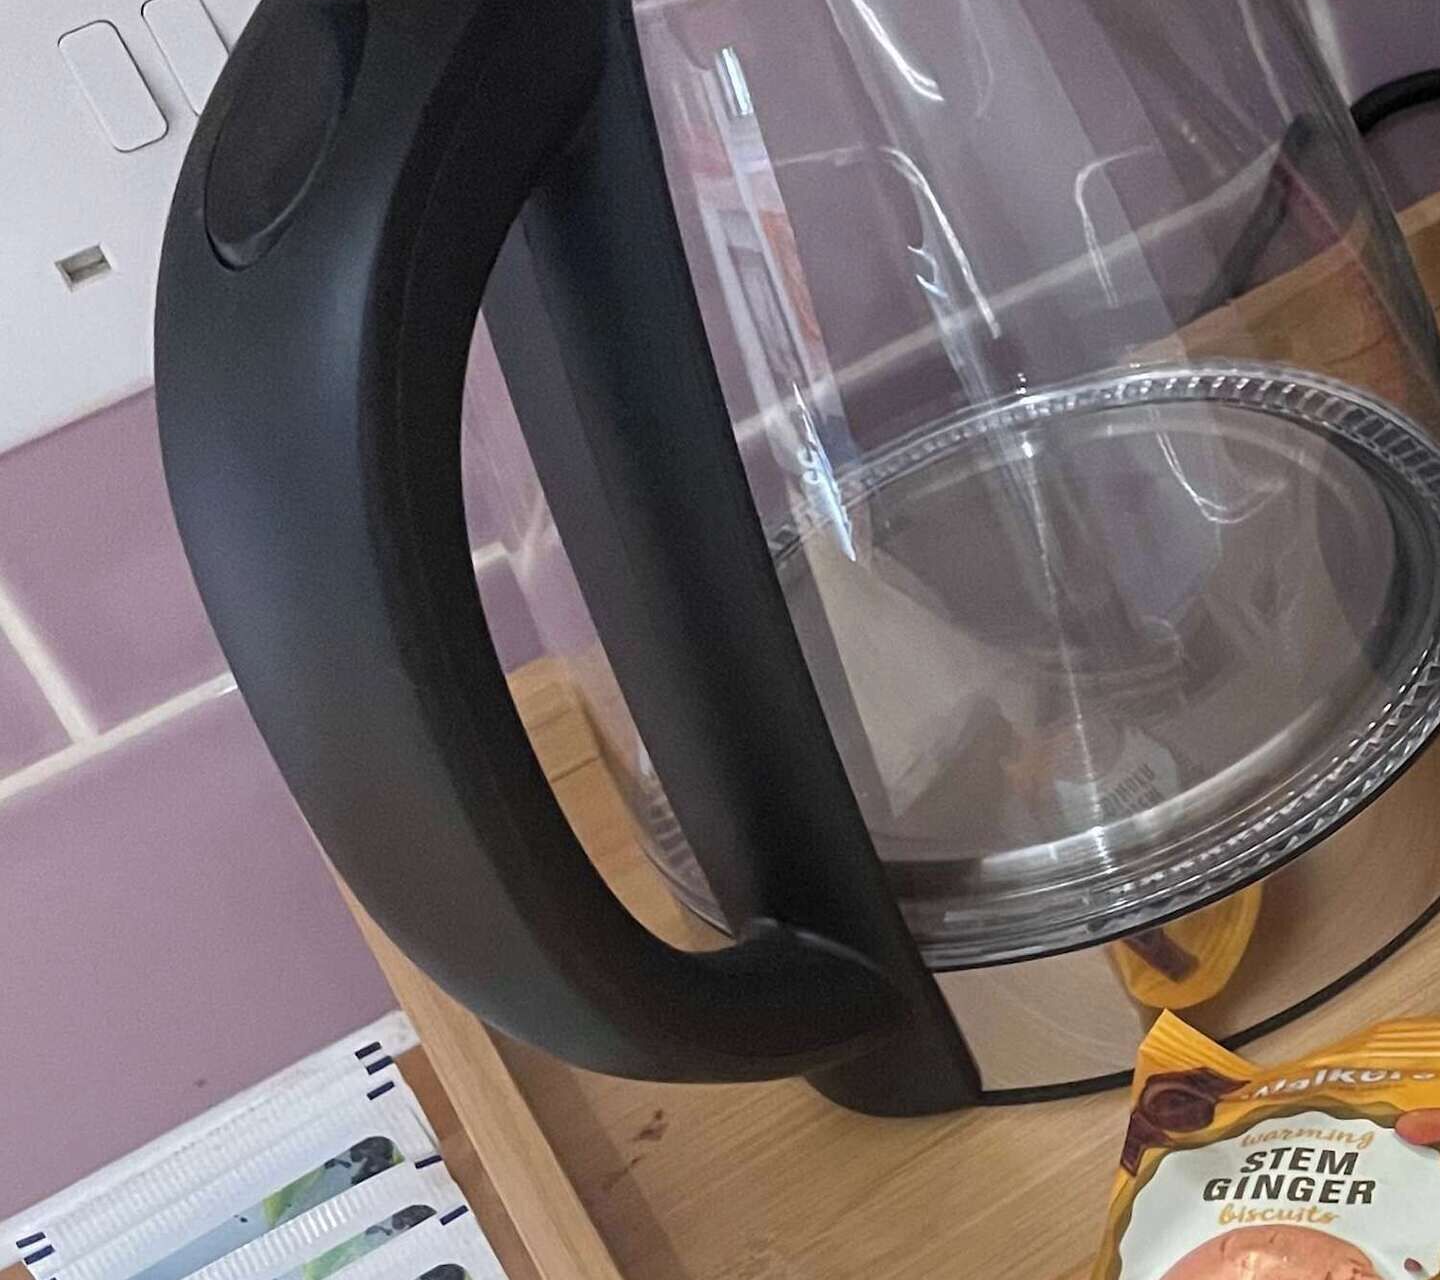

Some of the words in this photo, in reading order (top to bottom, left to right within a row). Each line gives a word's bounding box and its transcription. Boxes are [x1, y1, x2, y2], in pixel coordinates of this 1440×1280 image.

[1241, 1128, 1376, 1150] warming
[1240, 1147, 1360, 1175] STEM
[1203, 1174, 1377, 1205] GINGER
[1218, 1203, 1341, 1225] biscuits
